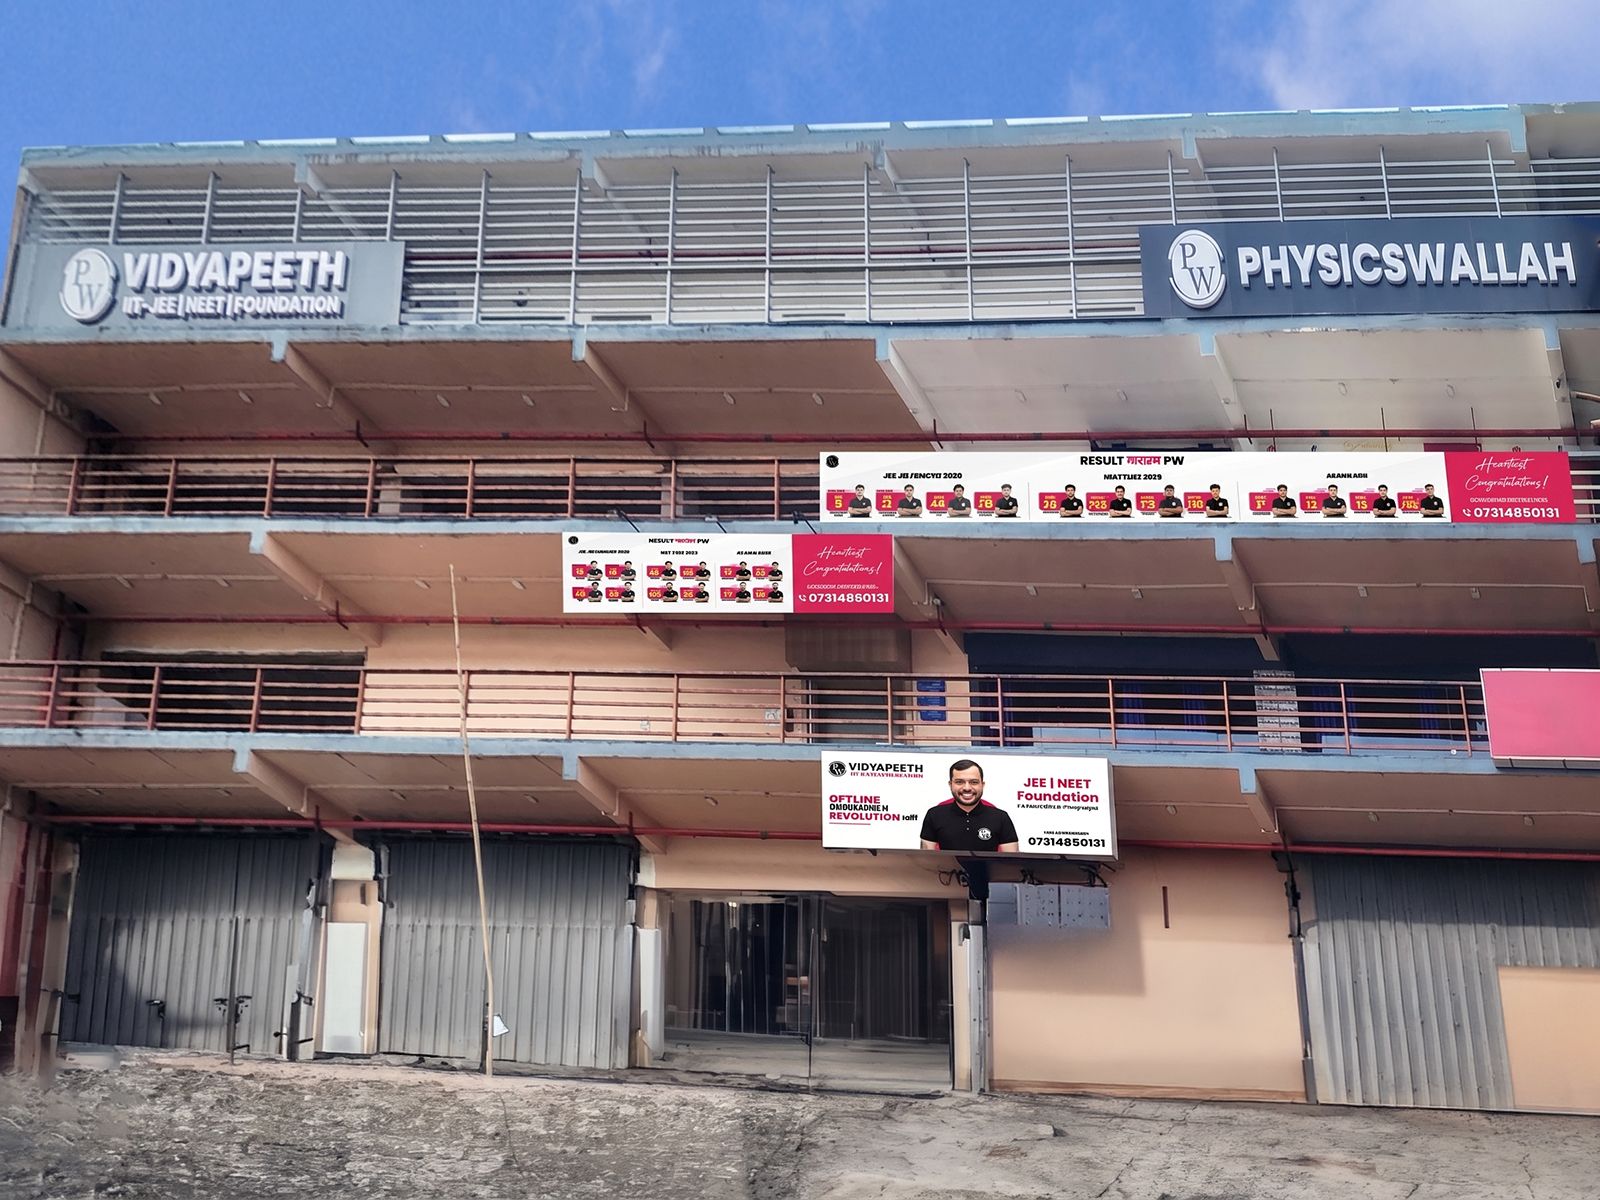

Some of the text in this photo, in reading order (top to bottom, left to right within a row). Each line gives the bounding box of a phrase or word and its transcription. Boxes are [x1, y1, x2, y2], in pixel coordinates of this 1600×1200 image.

[1237, 241, 1577, 287] PHYSICSWALLAH
[123, 251, 347, 291] VIDYAPEETH
[1080, 456, 1124, 465] RESULT
[1163, 456, 1184, 465] PW
[1473, 507, 1560, 518] 07314850131
[849, 762, 923, 773] VIDYAPEETH
[1023, 778, 1047, 788] JEE
[1057, 779, 1091, 789] NEET
[1017, 791, 1099, 802] Foundation
[829, 812, 900, 821] REVOLUTION
[1028, 837, 1106, 847] 07314850131
